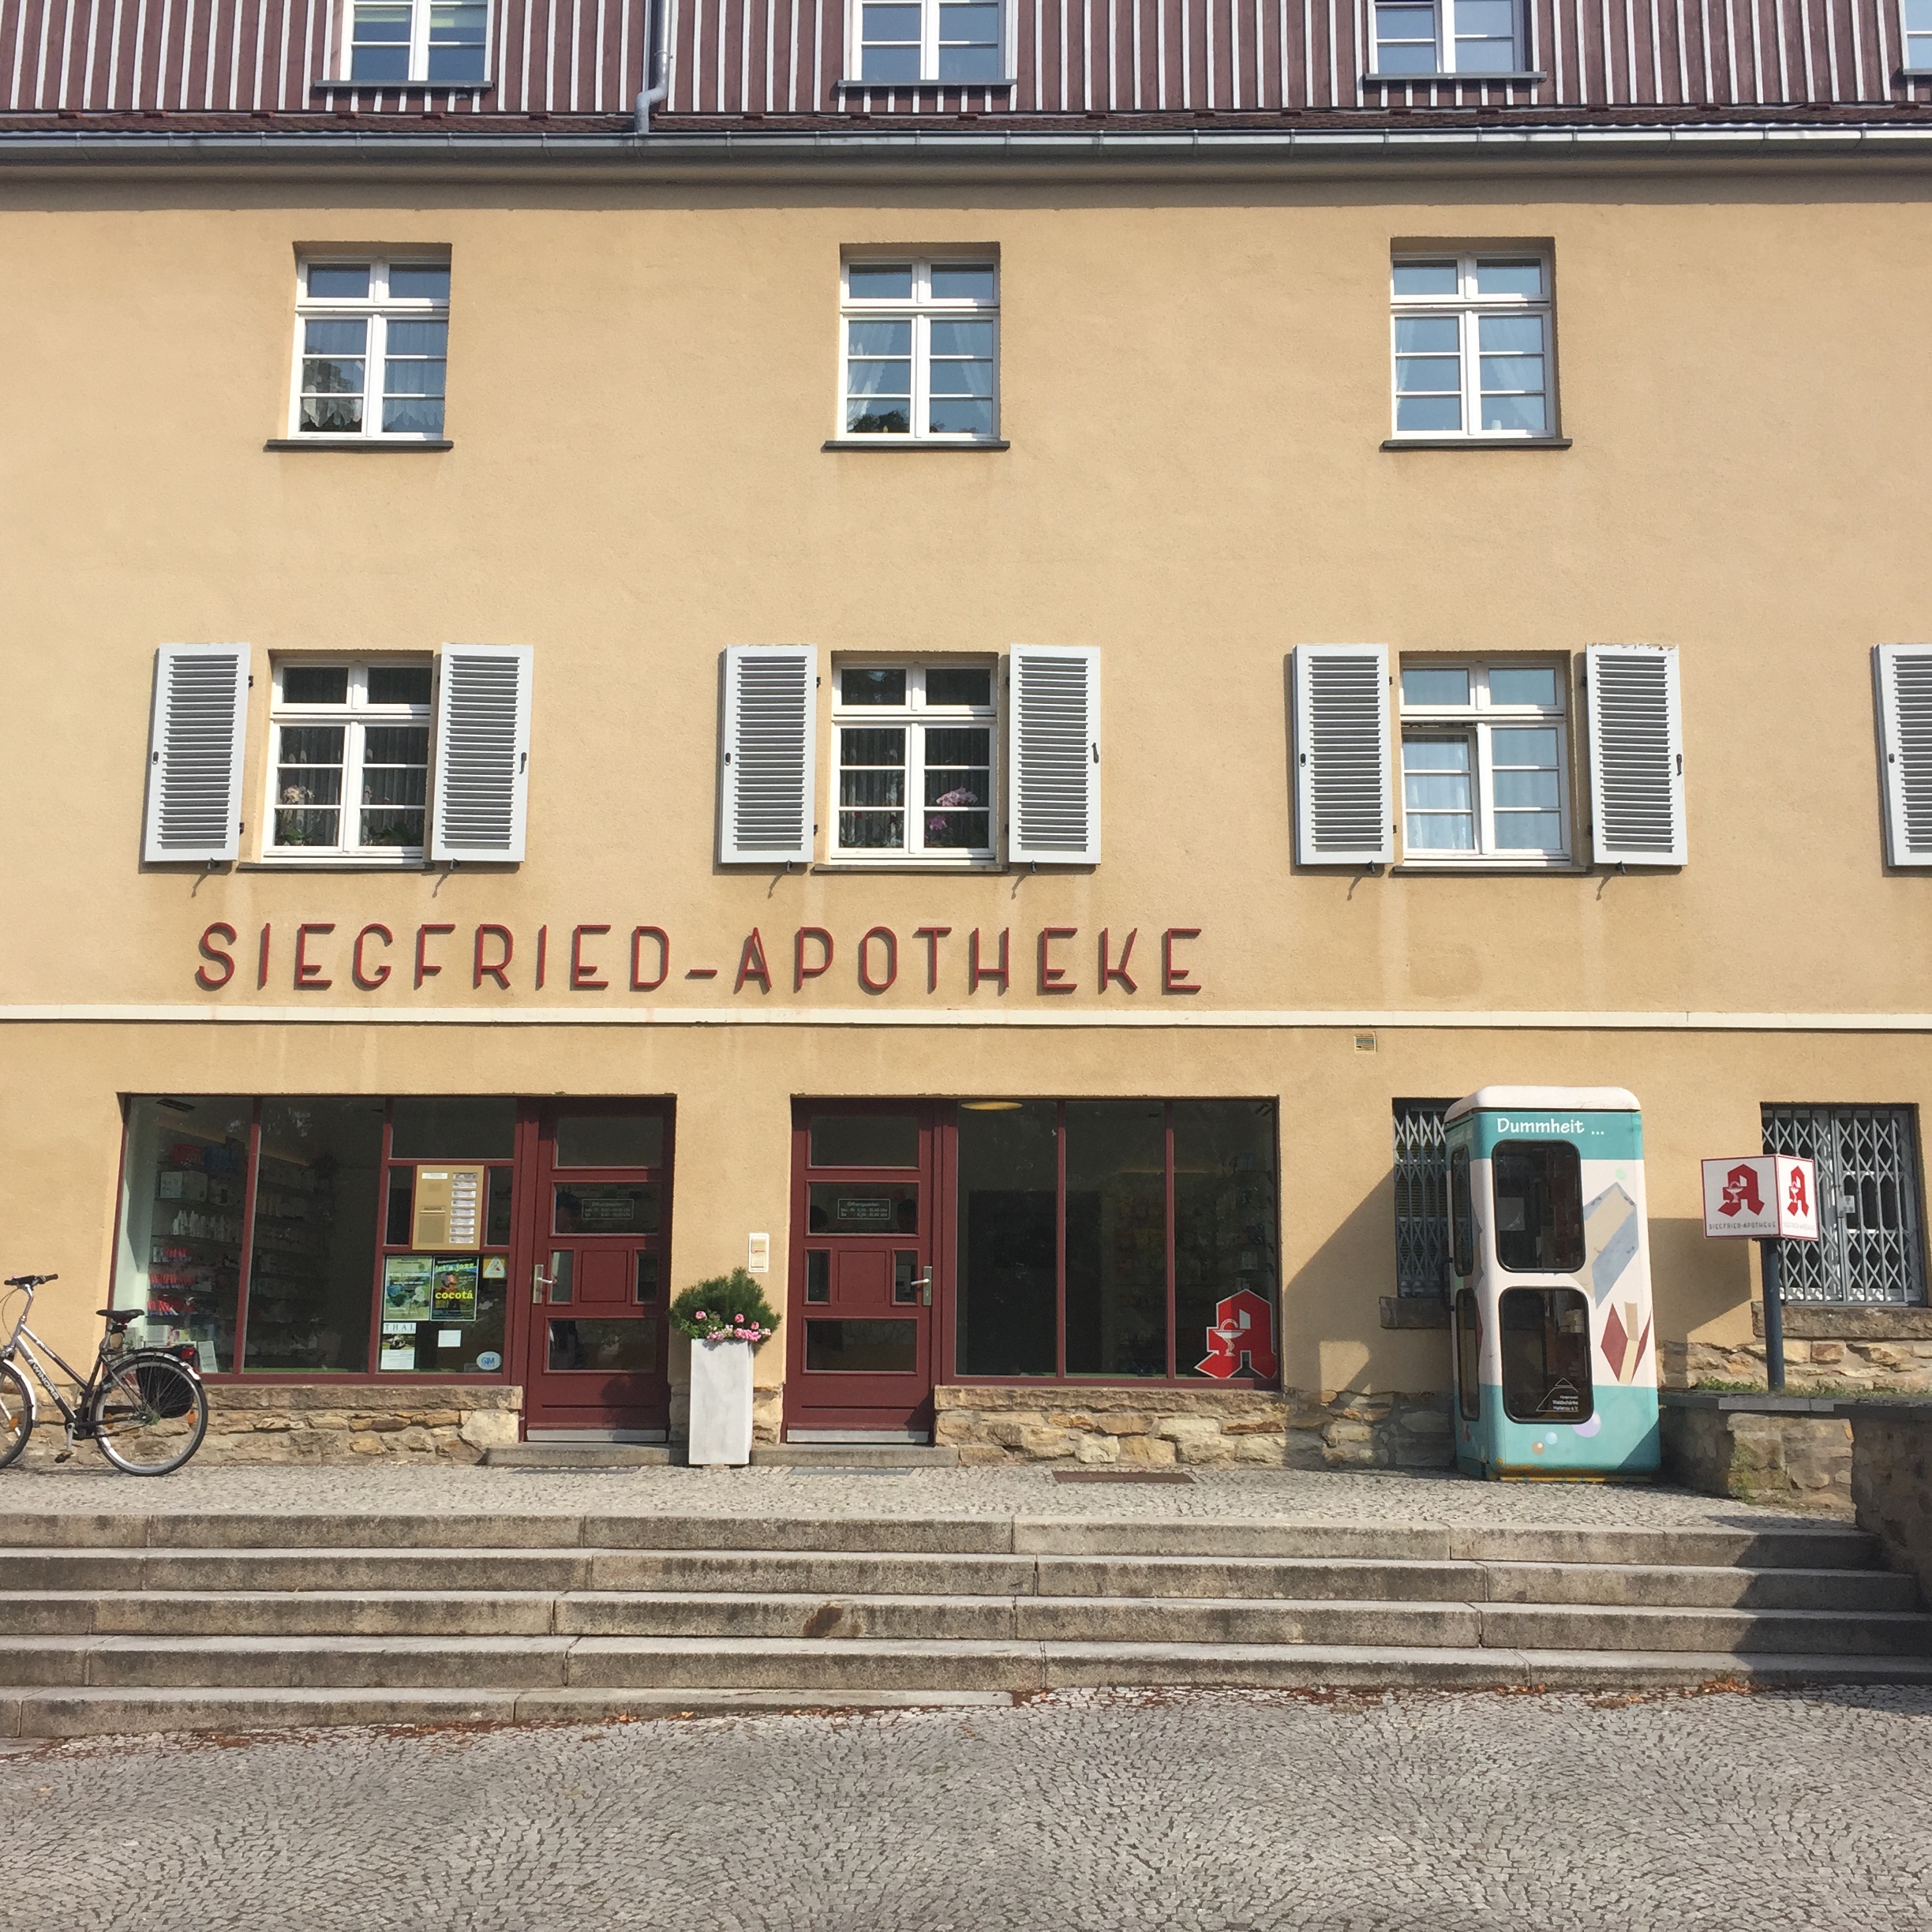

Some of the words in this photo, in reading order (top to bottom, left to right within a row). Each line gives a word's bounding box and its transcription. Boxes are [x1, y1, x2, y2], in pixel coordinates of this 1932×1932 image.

[197, 922, 1202, 992] SIEGFRIED-APOTHEKE
[1496, 1118, 1585, 1133] Dummheit
[435, 1290, 474, 1299] cocotá
